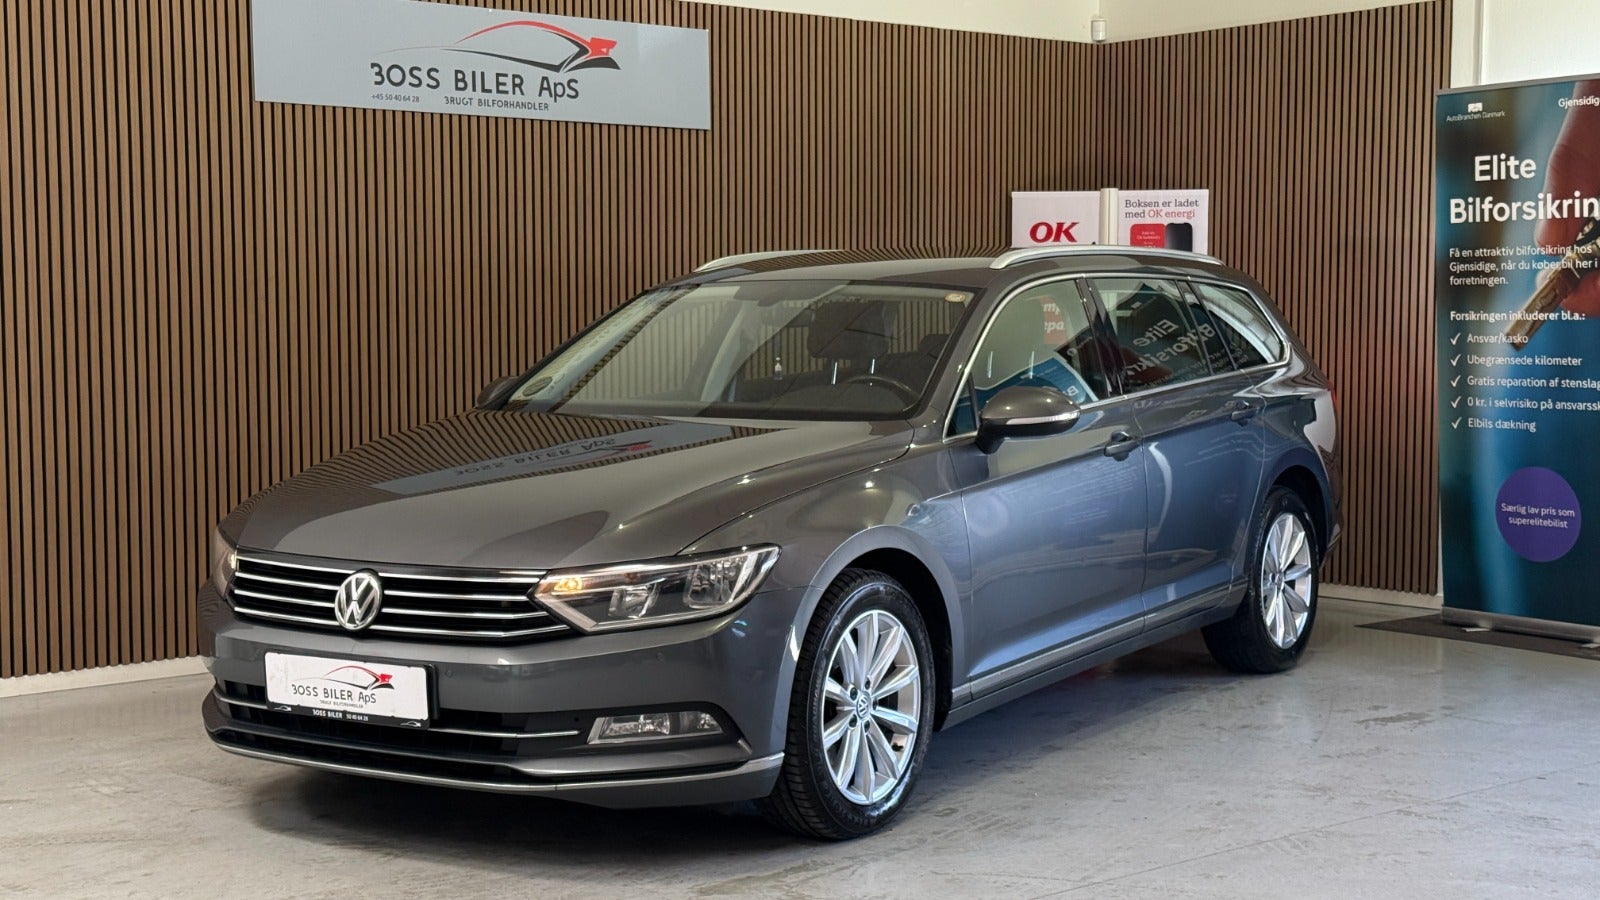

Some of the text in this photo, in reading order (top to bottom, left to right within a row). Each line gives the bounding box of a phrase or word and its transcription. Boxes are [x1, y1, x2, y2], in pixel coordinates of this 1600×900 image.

[454, 69, 525, 96] BILER
[538, 75, 580, 103] ApS
[371, 92, 384, 101] +45
[385, 93, 393, 101] 50
[394, 94, 402, 102] 40
[412, 95, 420, 103] 28
[477, 98, 549, 111] BILFORHANDLER
[1482, 110, 1505, 119] Danmark
[1474, 153, 1537, 182] Elite
[1125, 199, 1160, 208] Boksen
[1174, 199, 1200, 208] ladet
[1125, 209, 1195, 219] med OK energi
[1029, 221, 1080, 243] OK
[1449, 244, 1592, 258] Få en attraktiv bilforsikring hos
[1449, 261, 1499, 273] Gjensidige,
[1500, 258, 1517, 270] når
[1518, 259, 1530, 269] du
[1532, 258, 1560, 269] køber
[1561, 258, 1573, 269] bil
[1575, 257, 1593, 268] her
[1449, 275, 1509, 287] forretningen.
[1450, 310, 1586, 323] Forsikringen inkluderer bl.a.:
[1467, 332, 1529, 344] Ansvar/kasko
[1467, 354, 1583, 367] Ubegrænsede kilometer
[1467, 375, 1495, 386] Gratis
[1497, 377, 1547, 388] reparation
[1548, 377, 1560, 388] af
[1467, 397, 1474, 407] 0
[1475, 397, 1487, 407] kr.
[1494, 397, 1538, 409] selvrisiko
[1540, 398, 1553, 411] på
[1468, 417, 1537, 432] Elbils dækning
[1501, 502, 1575, 517] Særlig lav pris som
[1508, 517, 1568, 528] superelitebilist
[323, 687, 353, 702] BILER
[358, 691, 377, 705] ApS
[327, 710, 343, 719] BILER
